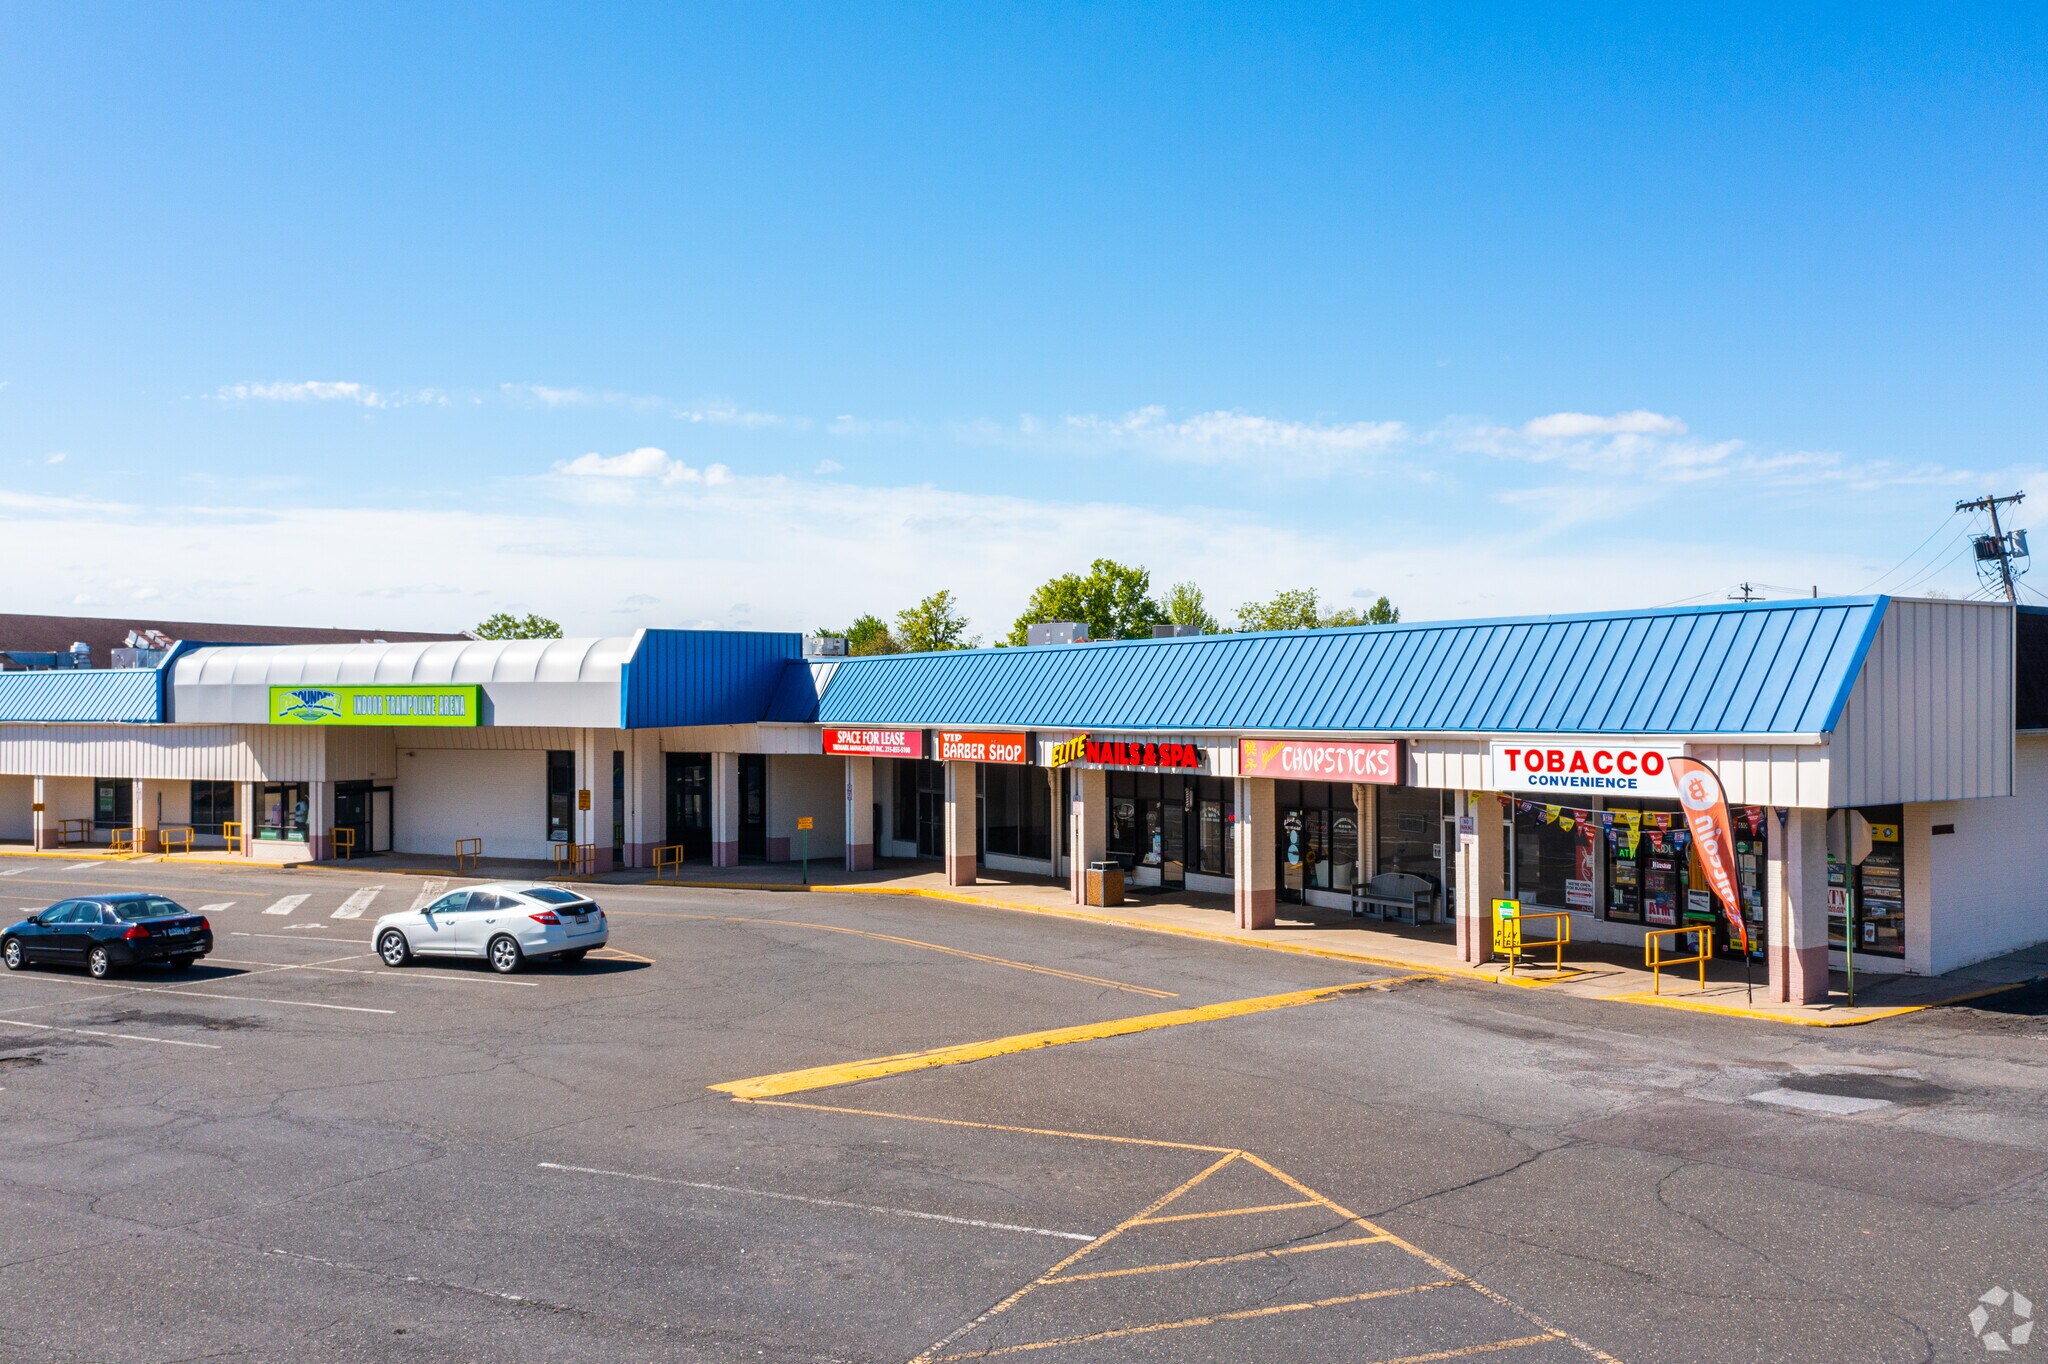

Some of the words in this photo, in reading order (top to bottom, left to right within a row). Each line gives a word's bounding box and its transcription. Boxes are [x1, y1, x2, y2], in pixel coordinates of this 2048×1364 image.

[353, 695, 383, 715] INDOOR
[385, 695, 436, 716] TRAMPOLINE
[438, 695, 465, 716] ARENA
[837, 731, 861, 744] SPACE
[862, 731, 880, 745] FOR
[881, 732, 905, 746] LEASE
[943, 733, 962, 742] VIP
[943, 742, 985, 760] BARBER
[989, 744, 1022, 761] SHOP
[1051, 734, 1087, 767] ELITE
[1261, 741, 1285, 771] Golden
[1282, 746, 1390, 776] CHOPSTICKS
[1504, 749, 1664, 776] TOBACCO
[1528, 775, 1638, 789] CONVENIENCE
